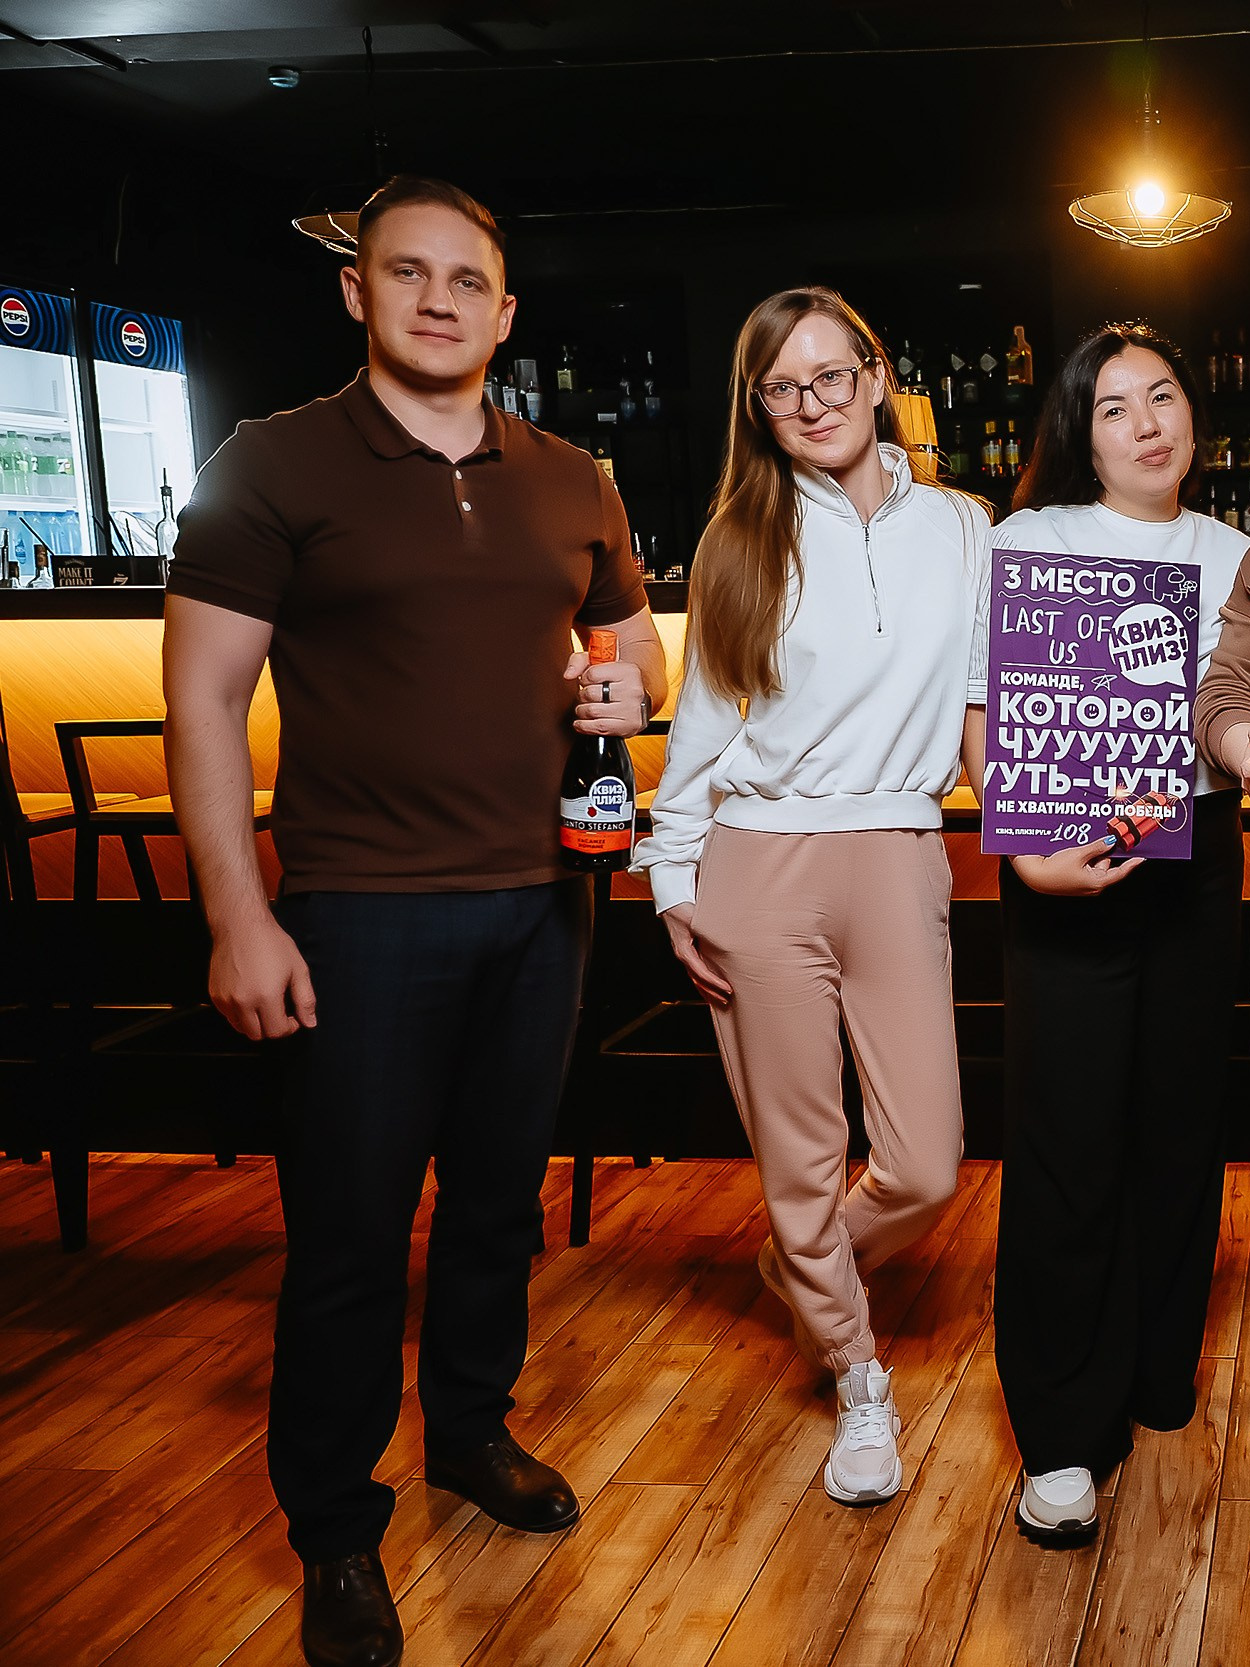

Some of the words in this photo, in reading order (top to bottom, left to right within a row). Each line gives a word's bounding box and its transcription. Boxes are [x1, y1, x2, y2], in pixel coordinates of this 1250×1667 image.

[3, 311, 28, 322] PEPSI
[123, 333, 145, 344] PEPSI
[58, 567, 82, 578] MAKE
[84, 567, 93, 578] IT
[1003, 564, 1022, 590] 3
[1030, 565, 1136, 598] МЕСТО
[1001, 604, 1064, 636] LAST
[1078, 613, 1114, 642] OF
[1048, 638, 1080, 664] US
[1000, 671, 1085, 691] КОМАНДЕ,
[999, 691, 1189, 731] КОТОРОЙ
[996, 800, 1016, 813] НЕ
[1017, 801, 1088, 815] ХВАТИЛО
[1089, 803, 1112, 818] ДО
[1114, 804, 1177, 819] ПОБЕДЫ
[588, 822, 625, 831] STEFANO
[1049, 822, 1092, 845] 108
